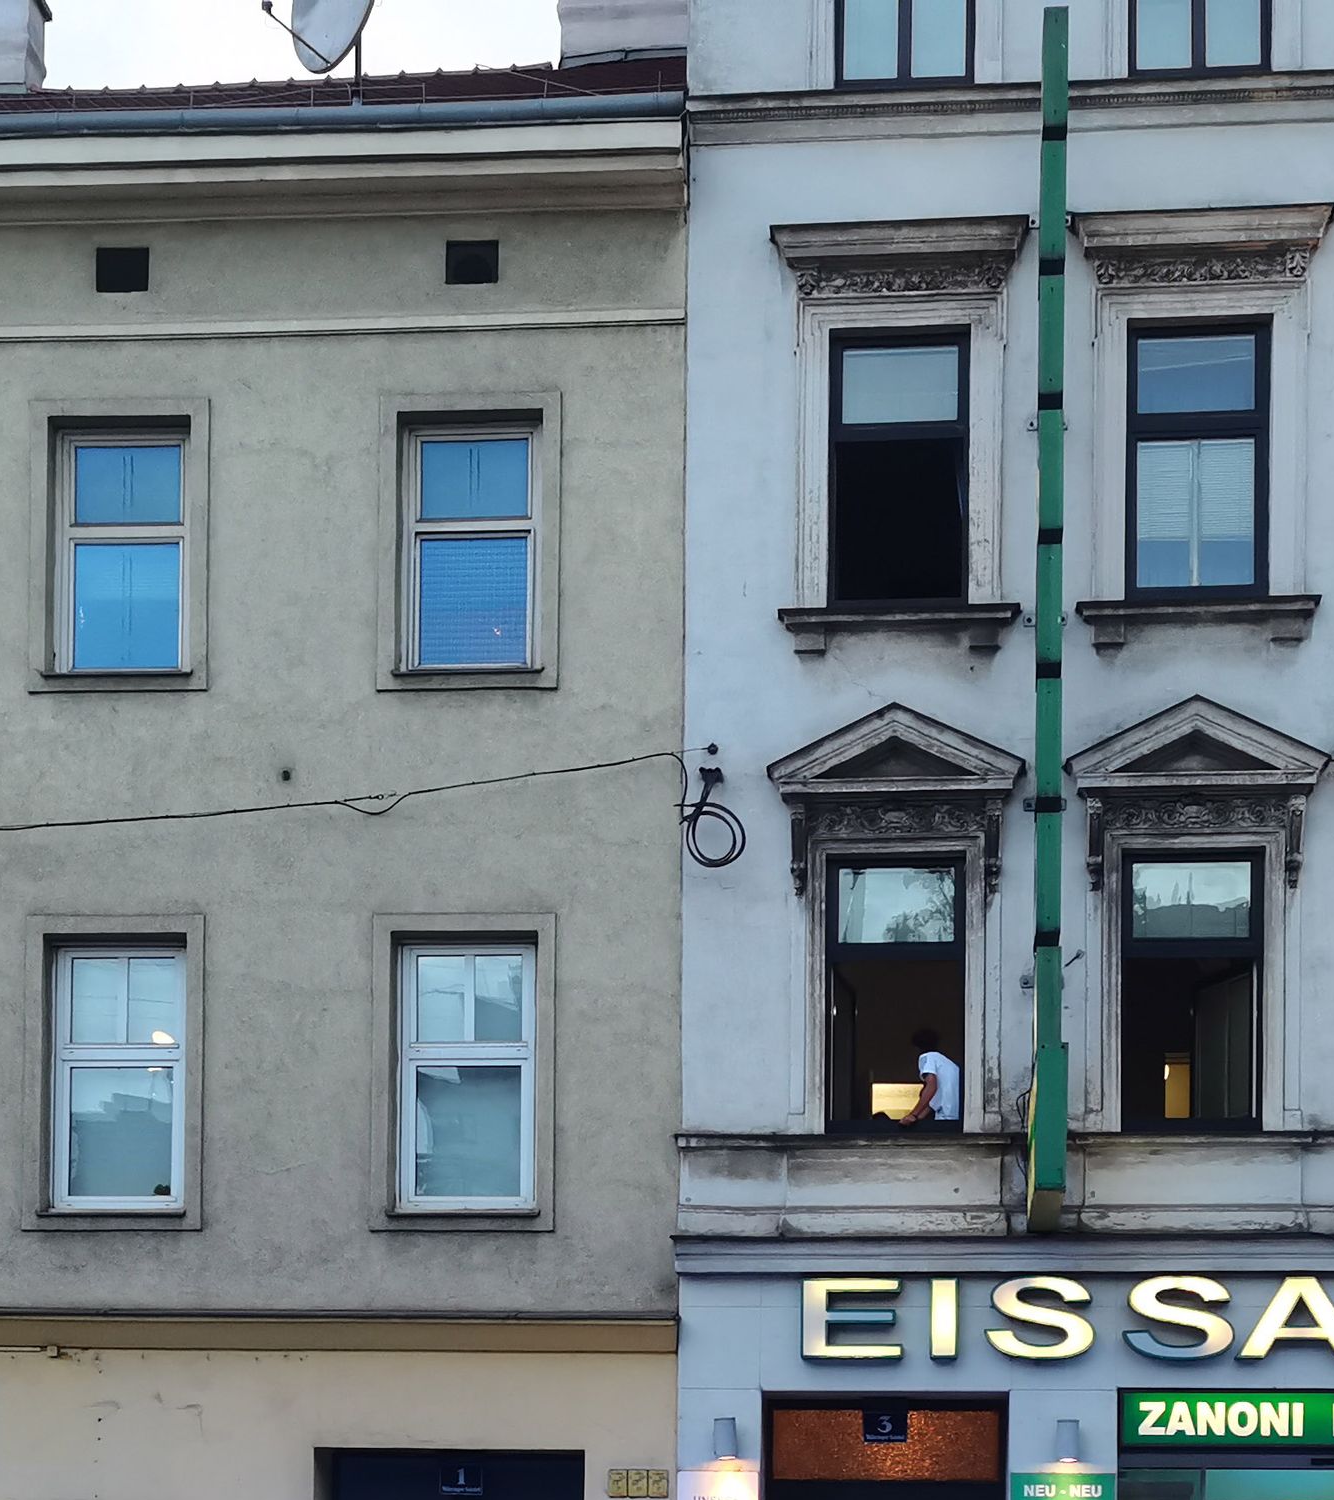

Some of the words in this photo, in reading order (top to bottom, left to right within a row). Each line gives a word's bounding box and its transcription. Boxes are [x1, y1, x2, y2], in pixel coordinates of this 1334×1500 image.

[877, 1415, 893, 1433] 3
[1138, 1401, 1305, 1438] ZANONI
[1023, 1484, 1056, 1497] NEU
[1069, 1484, 1102, 1497] NEU
